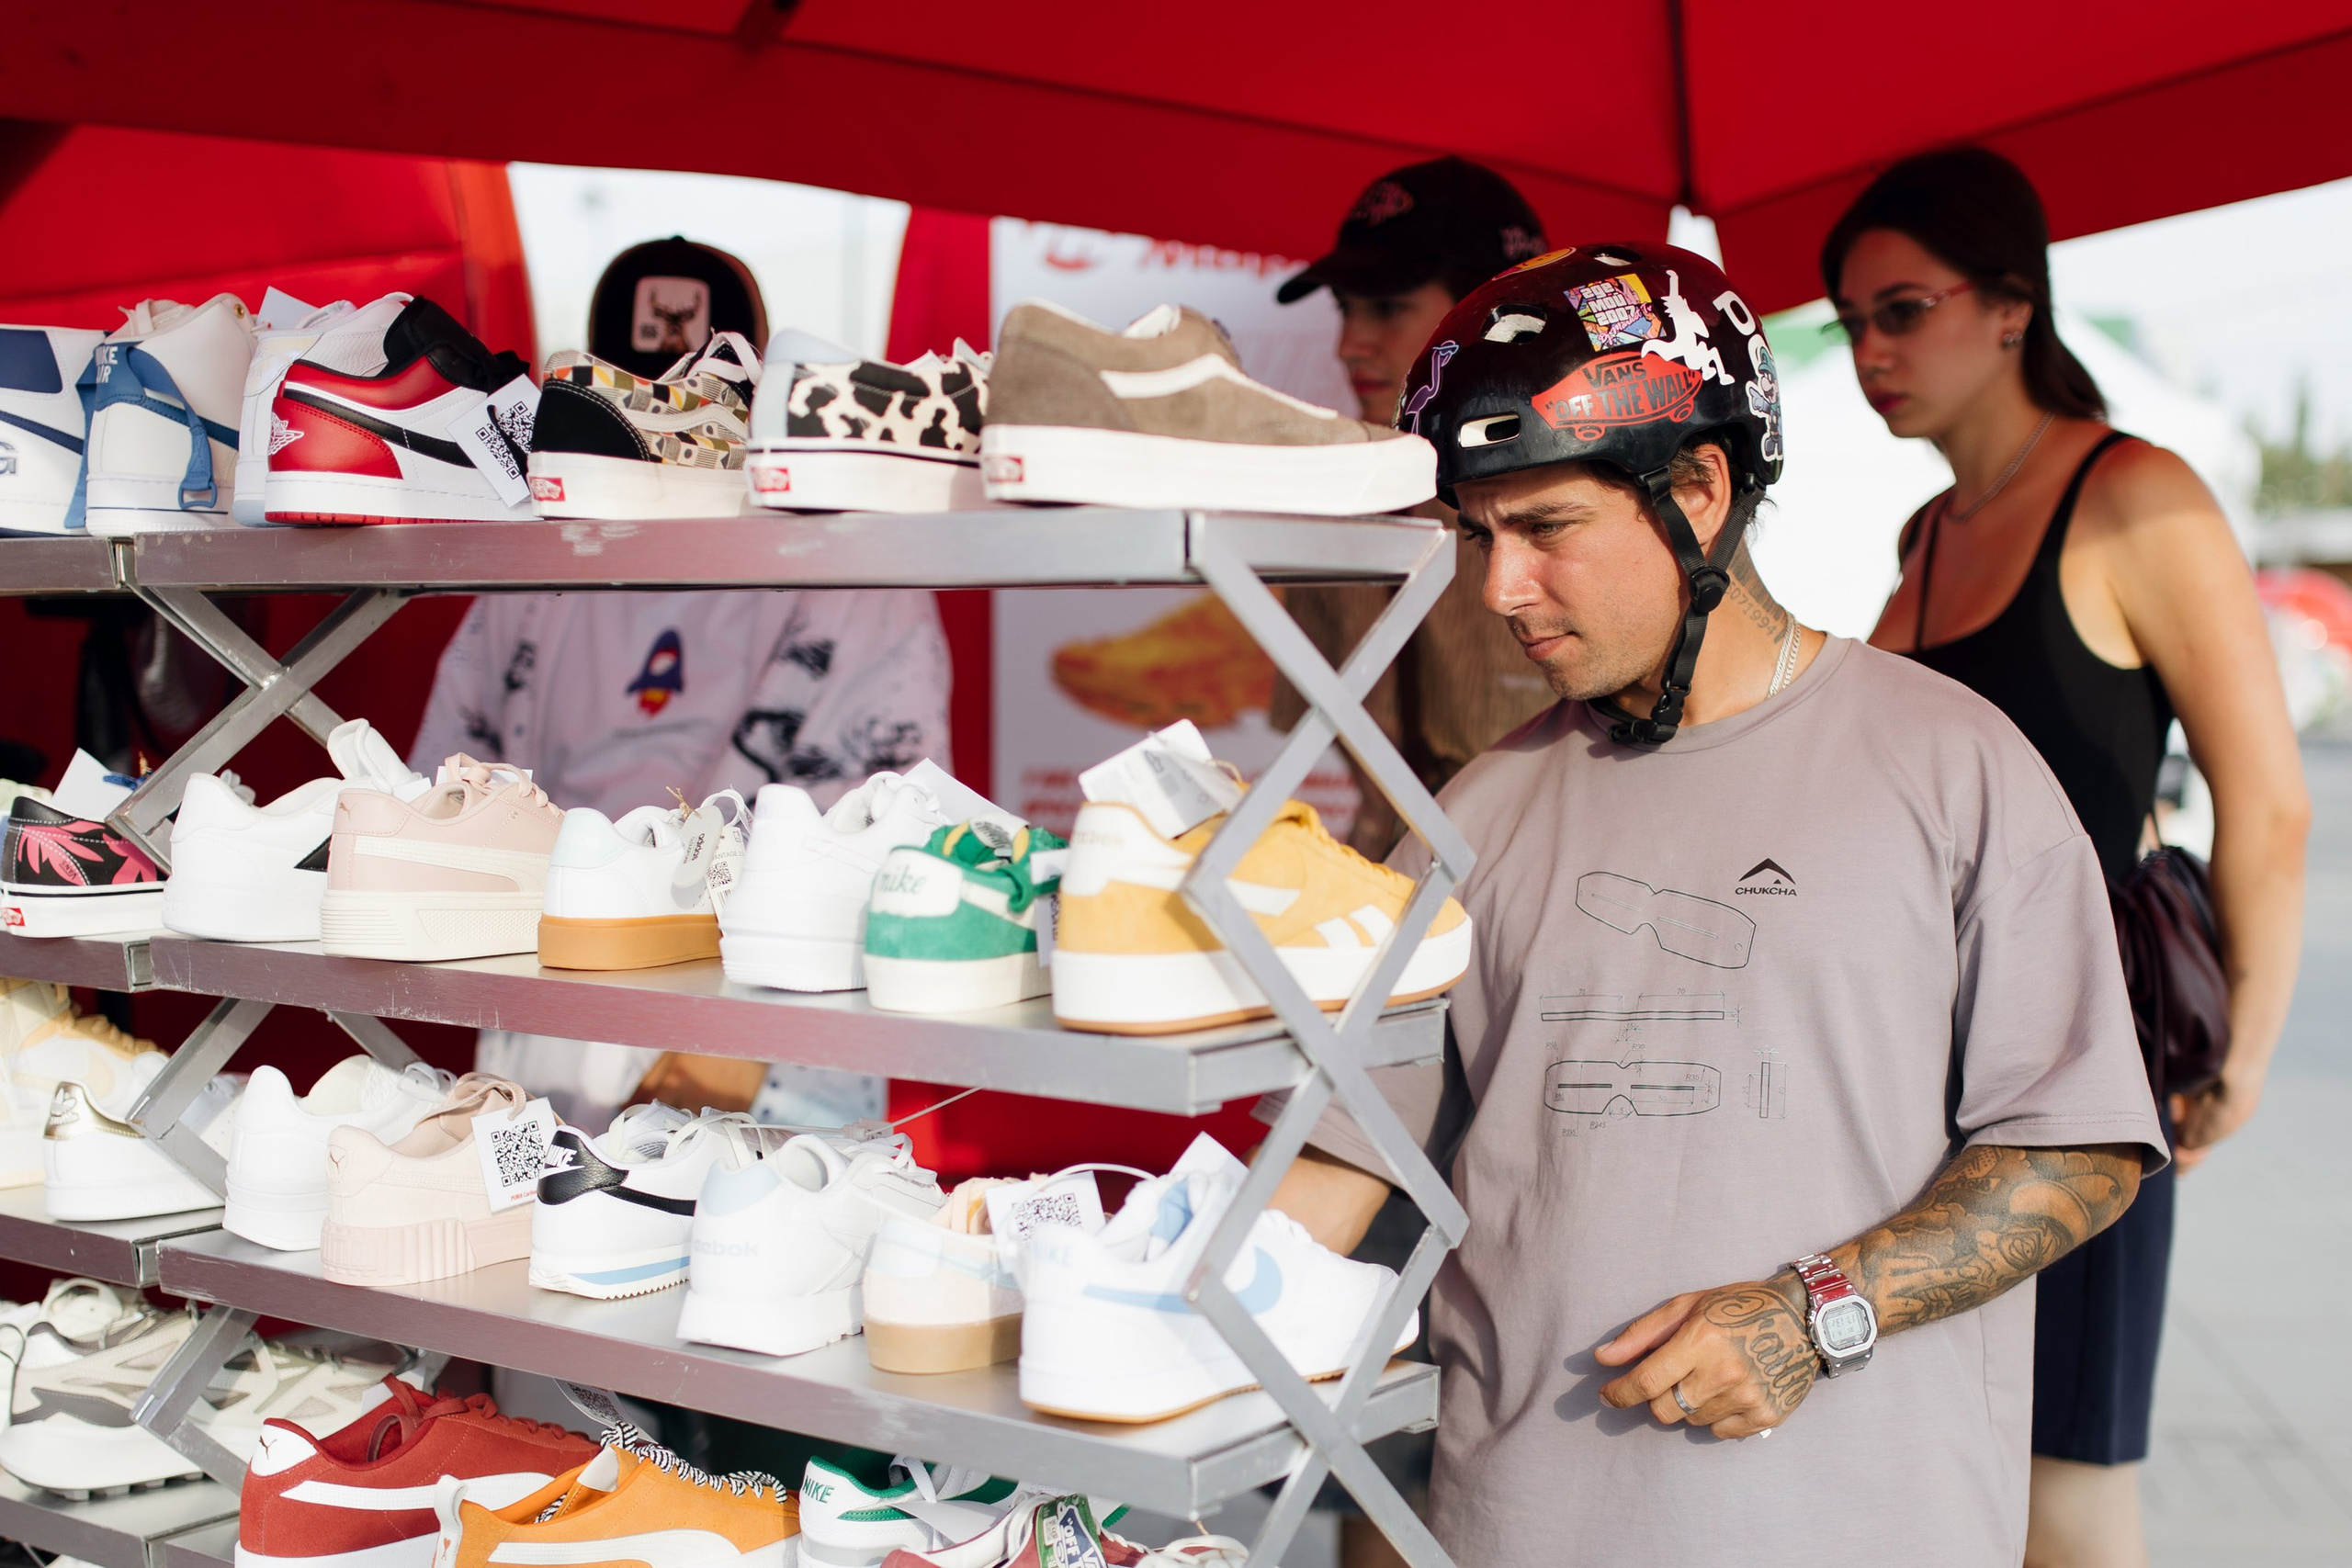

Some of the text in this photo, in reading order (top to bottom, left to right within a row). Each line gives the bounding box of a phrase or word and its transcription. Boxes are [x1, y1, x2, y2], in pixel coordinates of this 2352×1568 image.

[1594, 305, 1635, 326] 2007
[1582, 361, 1647, 389] VANS
[1596, 383, 1645, 417] THE
[714, 850, 738, 860] ANTAGE
[1735, 886, 1797, 897] CHUKCHA
[1685, 1073, 1700, 1081] R35
[693, 1238, 759, 1258] eebok
[802, 1474, 835, 1504] NIKE
